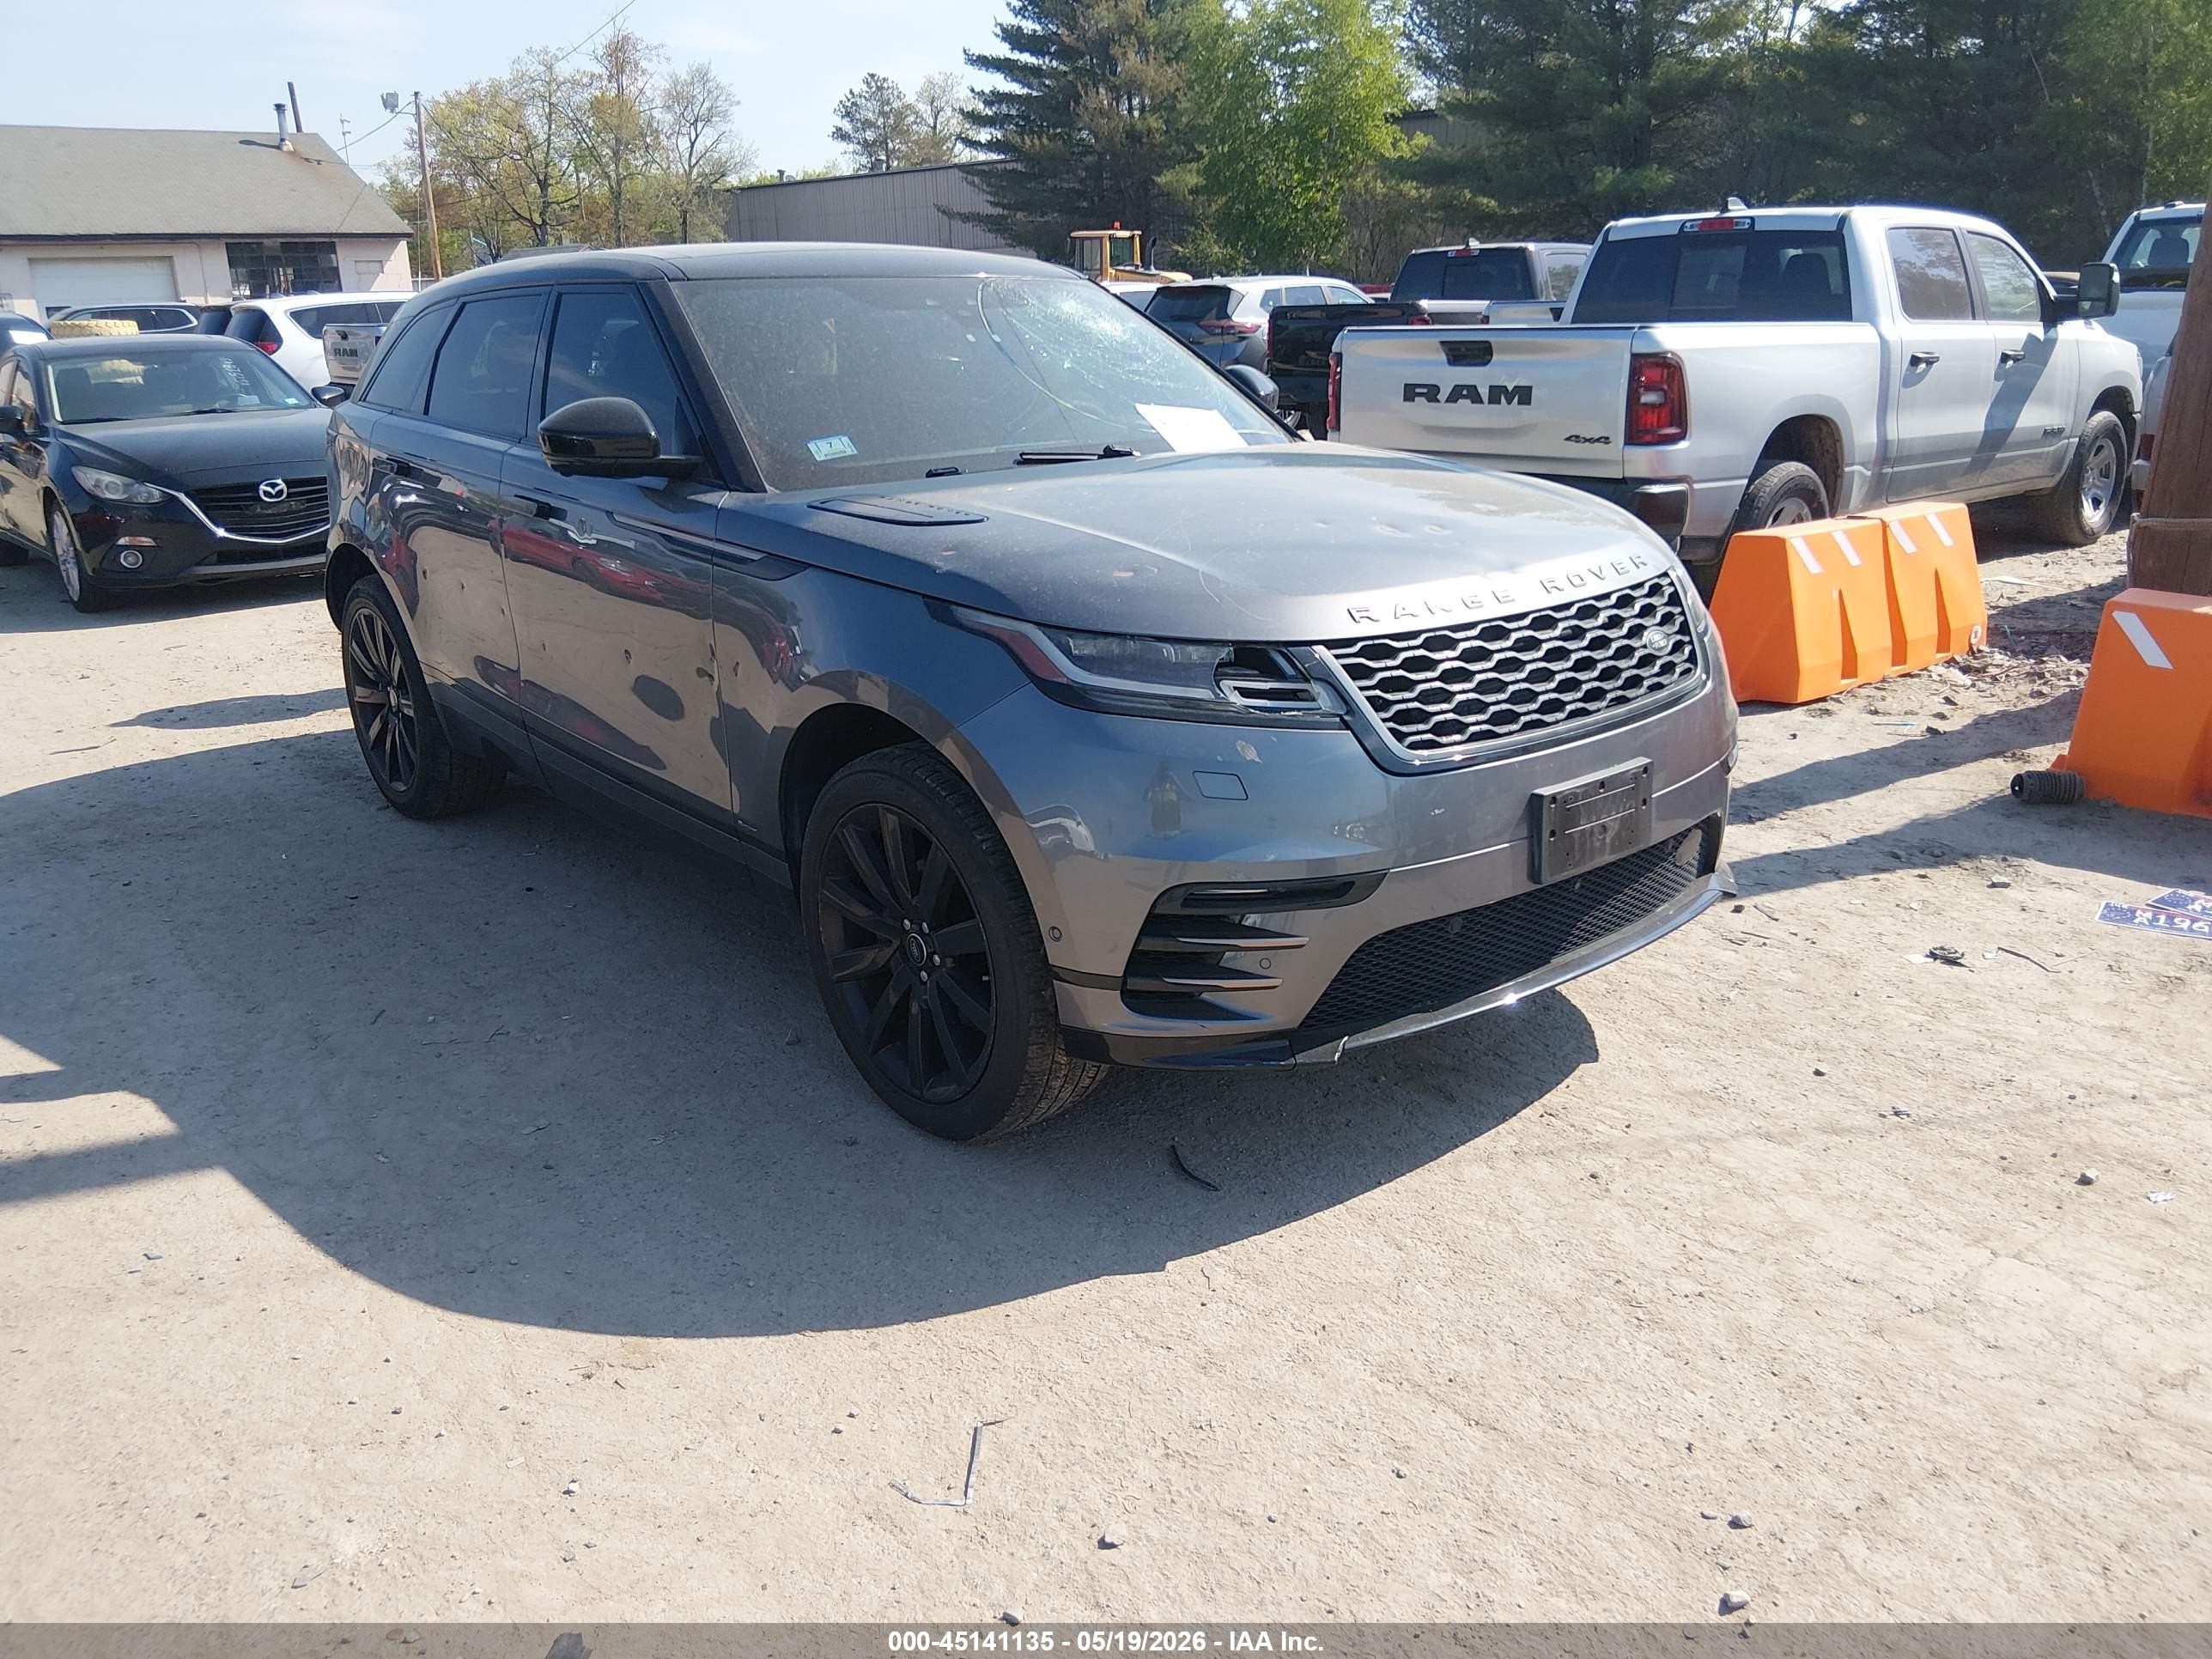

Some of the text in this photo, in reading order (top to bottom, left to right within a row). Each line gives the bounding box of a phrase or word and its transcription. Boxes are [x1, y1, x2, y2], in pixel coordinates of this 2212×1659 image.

[334, 348, 359, 358] RAM
[1402, 382, 1534, 406] RAM
[1563, 434, 1613, 445] 4x4
[1539, 554, 1650, 594] ROVER
